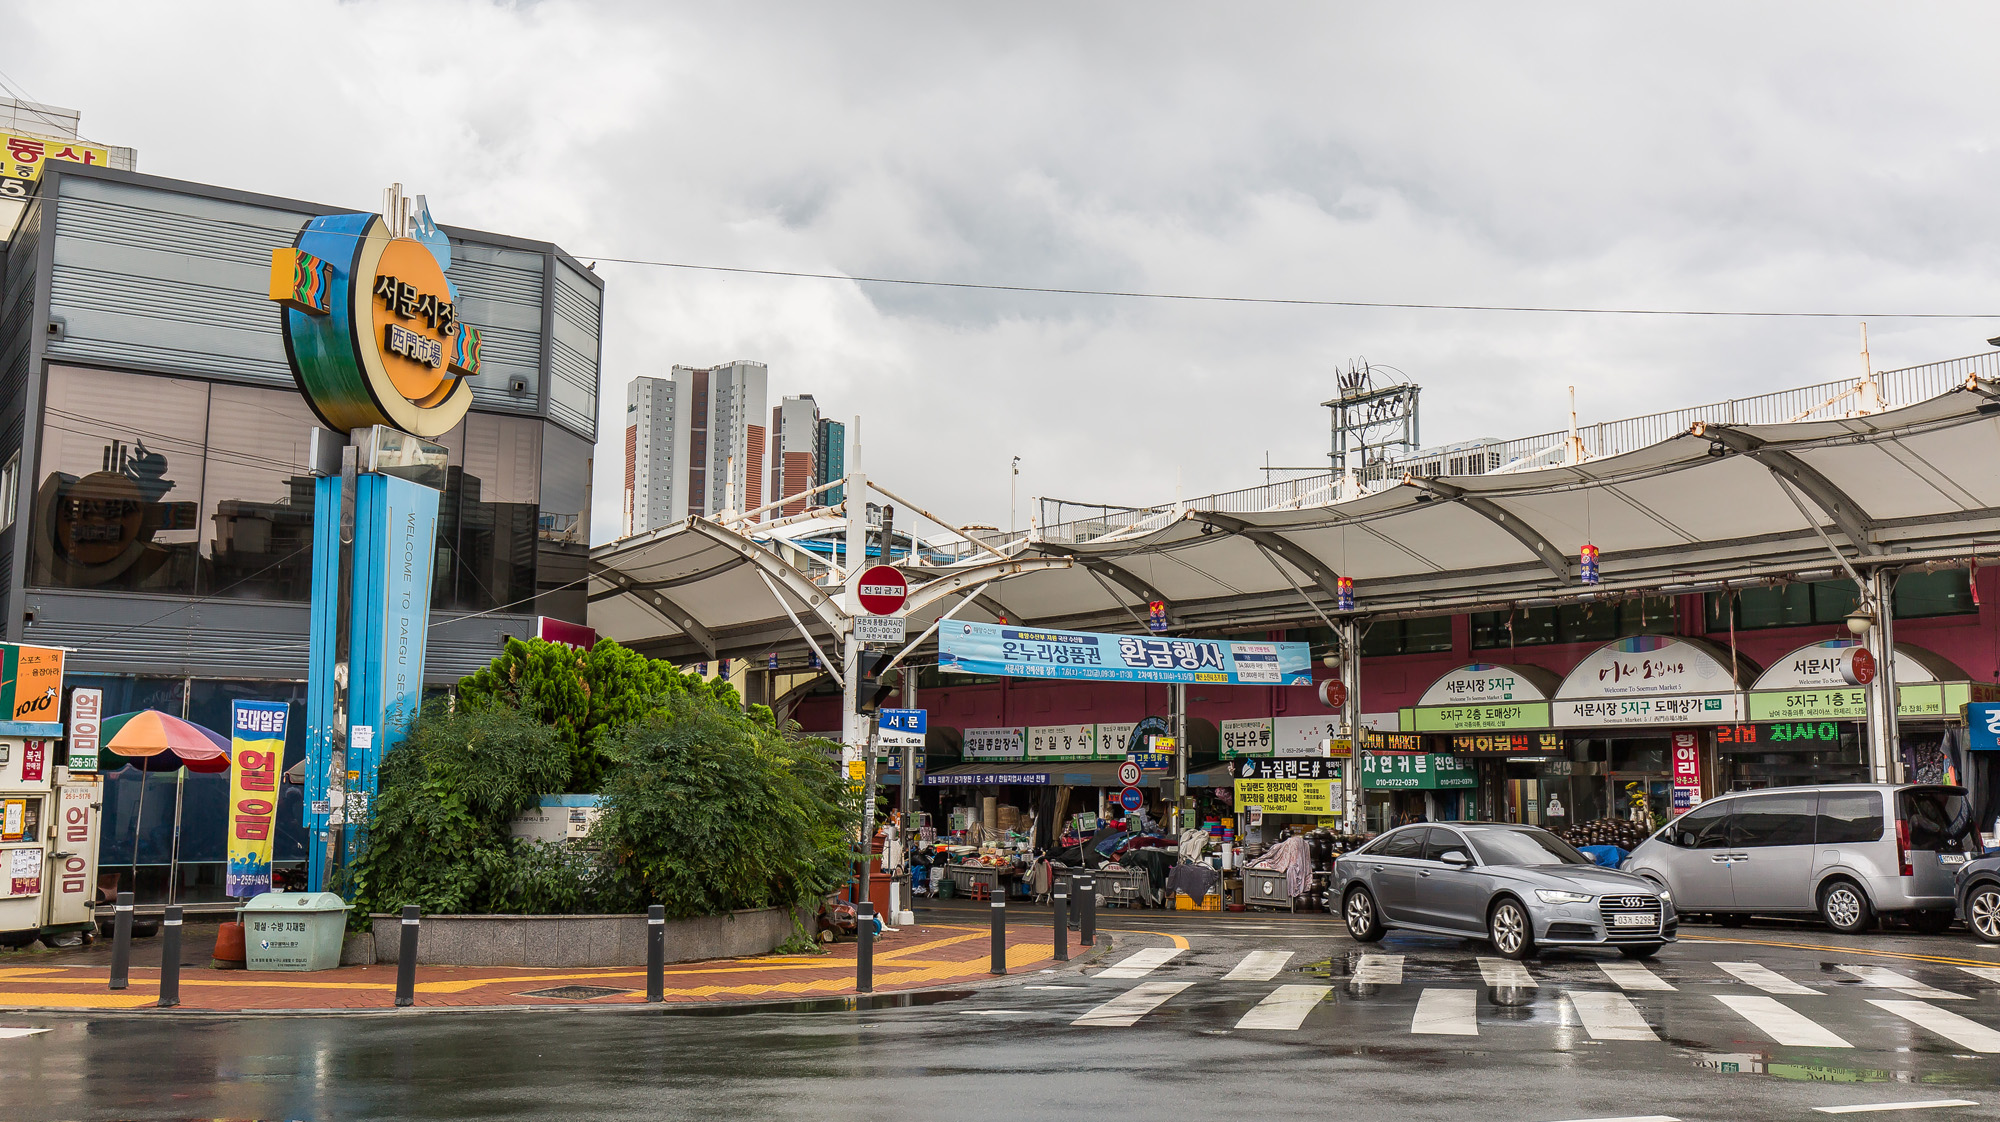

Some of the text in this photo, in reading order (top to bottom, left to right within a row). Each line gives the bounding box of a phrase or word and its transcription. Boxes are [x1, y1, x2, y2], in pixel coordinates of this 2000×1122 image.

[375, 276, 459, 336] 서문시장
[391, 323, 442, 369] 西門市場
[403, 512, 416, 582] WELCOME
[864, 586, 902, 595] 진입금지
[402, 591, 411, 610] TO
[398, 618, 409, 665] DAEGU
[21, 655, 41, 664] 스포츠
[1002, 637, 1225, 670] 온누리상품권 환급행사
[1004, 664, 1024, 675] 서문시장
[1599, 659, 1685, 683] 어서 오십시오
[1446, 678, 1515, 694] 서문시장 5지구
[1573, 702, 1617, 717] 서문시장
[1621, 701, 1651, 715] 5지구
[1655, 699, 1703, 714] 도매상가
[1787, 694, 1818, 707] 5지구
[1825, 694, 1845, 707] 1층
[1926, 703, 1939, 711] 커텐
[236, 708, 285, 732] 포대얼음
[1440, 706, 1521, 721] 5지구 2층 도매상가
[73, 695, 98, 749] 얼음
[970, 737, 1019, 751] 한일종합장식
[1224, 730, 1270, 748] 영남유통
[1389, 735, 1421, 750] MARKET
[26, 751, 41, 762] 복권
[1676, 734, 1695, 775] 항아리
[26, 762, 41, 770] 판매점
[1124, 768, 1136, 779] 30
[1261, 761, 1320, 779] 뉴질랜드#
[1240, 783, 1265, 792] 뉴질랜드
[1266, 782, 1298, 792] 청정지역의
[1376, 778, 1419, 786] 010-9722-0379
[1440, 778, 1473, 786] 010-9722-0379
[235, 750, 275, 841] 얼음
[1240, 793, 1298, 803] 깨끗함을 선물하세요
[62, 807, 89, 893] 얼음
[254, 922, 306, 932] 제설·수방 자재함
